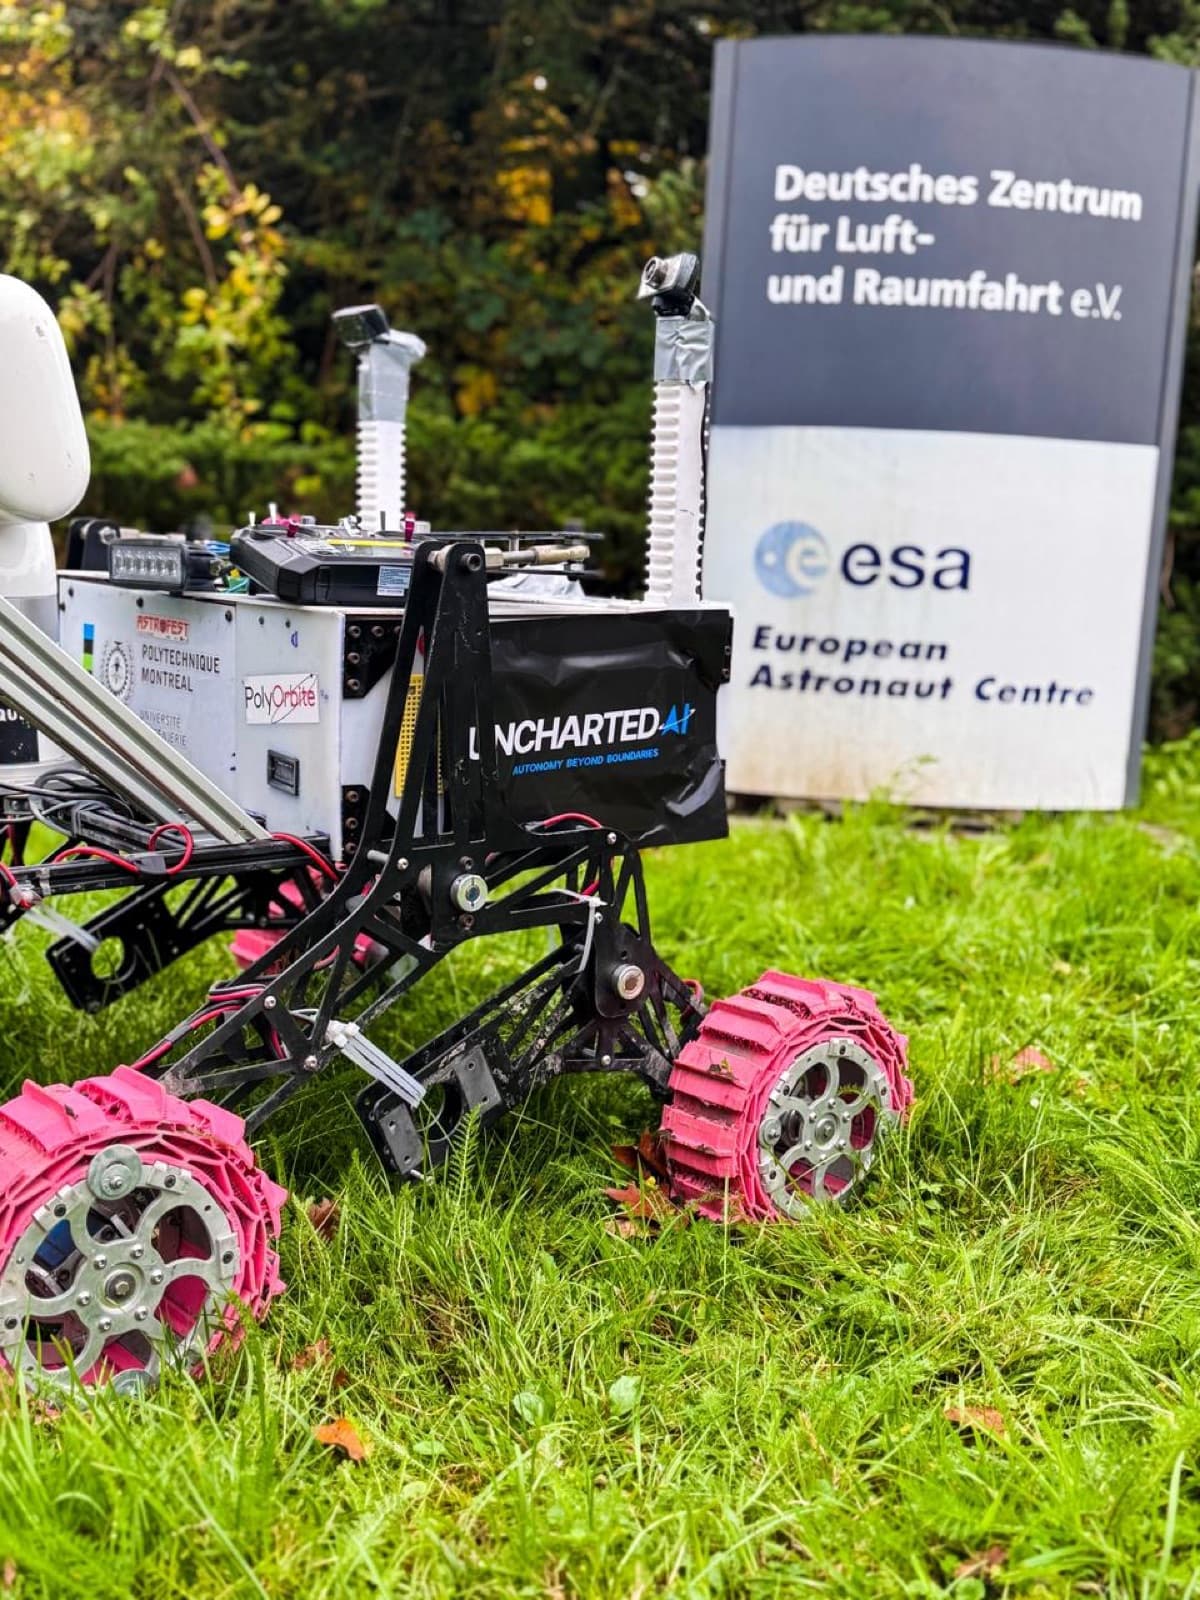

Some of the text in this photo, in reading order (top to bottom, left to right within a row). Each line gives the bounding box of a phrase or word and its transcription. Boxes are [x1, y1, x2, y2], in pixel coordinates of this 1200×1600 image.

[775, 164, 1142, 221] Deutsches Zentrum
[770, 214, 935, 254] für Luft-
[768, 266, 1122, 321] und Raumfahrt e.V.
[841, 542, 971, 592] esa
[142, 644, 220, 673] POLYTECHNIQUE
[752, 625, 949, 663] European
[244, 684, 315, 715] PolyOrbite
[749, 665, 1096, 707] Astronaut Centre
[512, 748, 659, 776] AUTONOMY BEYOND BOUNDARIES
